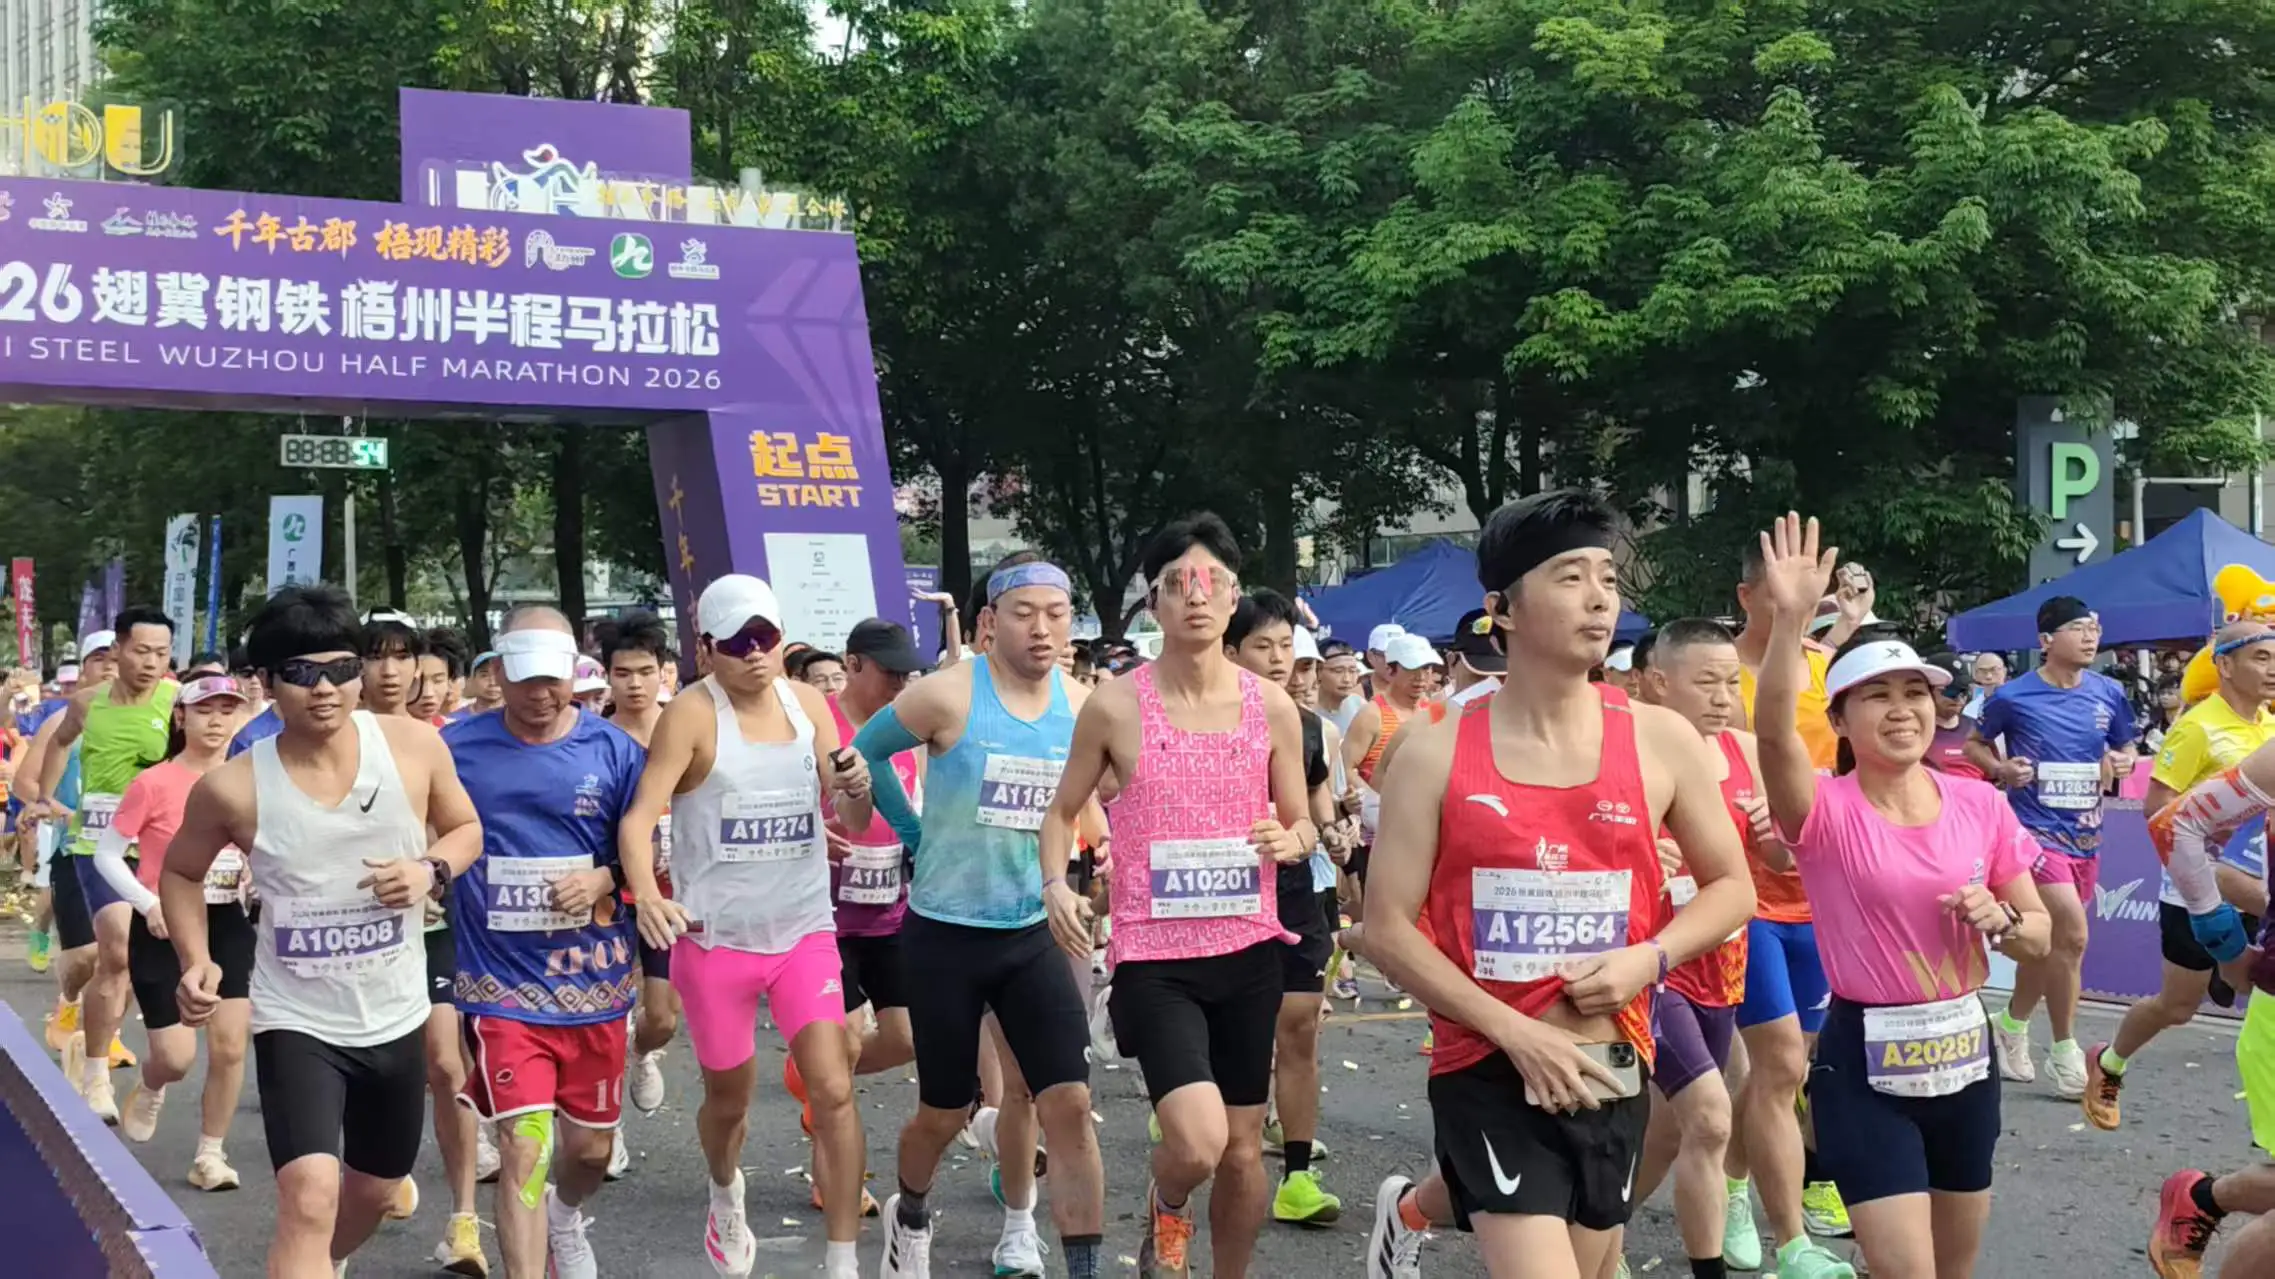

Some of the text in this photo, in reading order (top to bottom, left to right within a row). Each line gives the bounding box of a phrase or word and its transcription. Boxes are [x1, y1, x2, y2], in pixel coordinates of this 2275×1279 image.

[213, 208, 358, 262] 千年古郡
[373, 219, 512, 268] 梧现精彩
[29, 336, 140, 364] STEEL
[158, 343, 325, 373] WUZHOU
[340, 353, 428, 378] HALF
[442, 357, 631, 387] MARATHON
[644, 366, 722, 390] 2026
[749, 429, 860, 480] 起点
[757, 482, 864, 509] START
[2051, 441, 2100, 520] P
[729, 814, 809, 841] A11274
[1164, 867, 1252, 893] A10201
[2094, 877, 2161, 922] WINN
[287, 919, 395, 953] A10608
[1487, 911, 1616, 946] A12564
[1881, 1028, 1982, 1069] A20287
